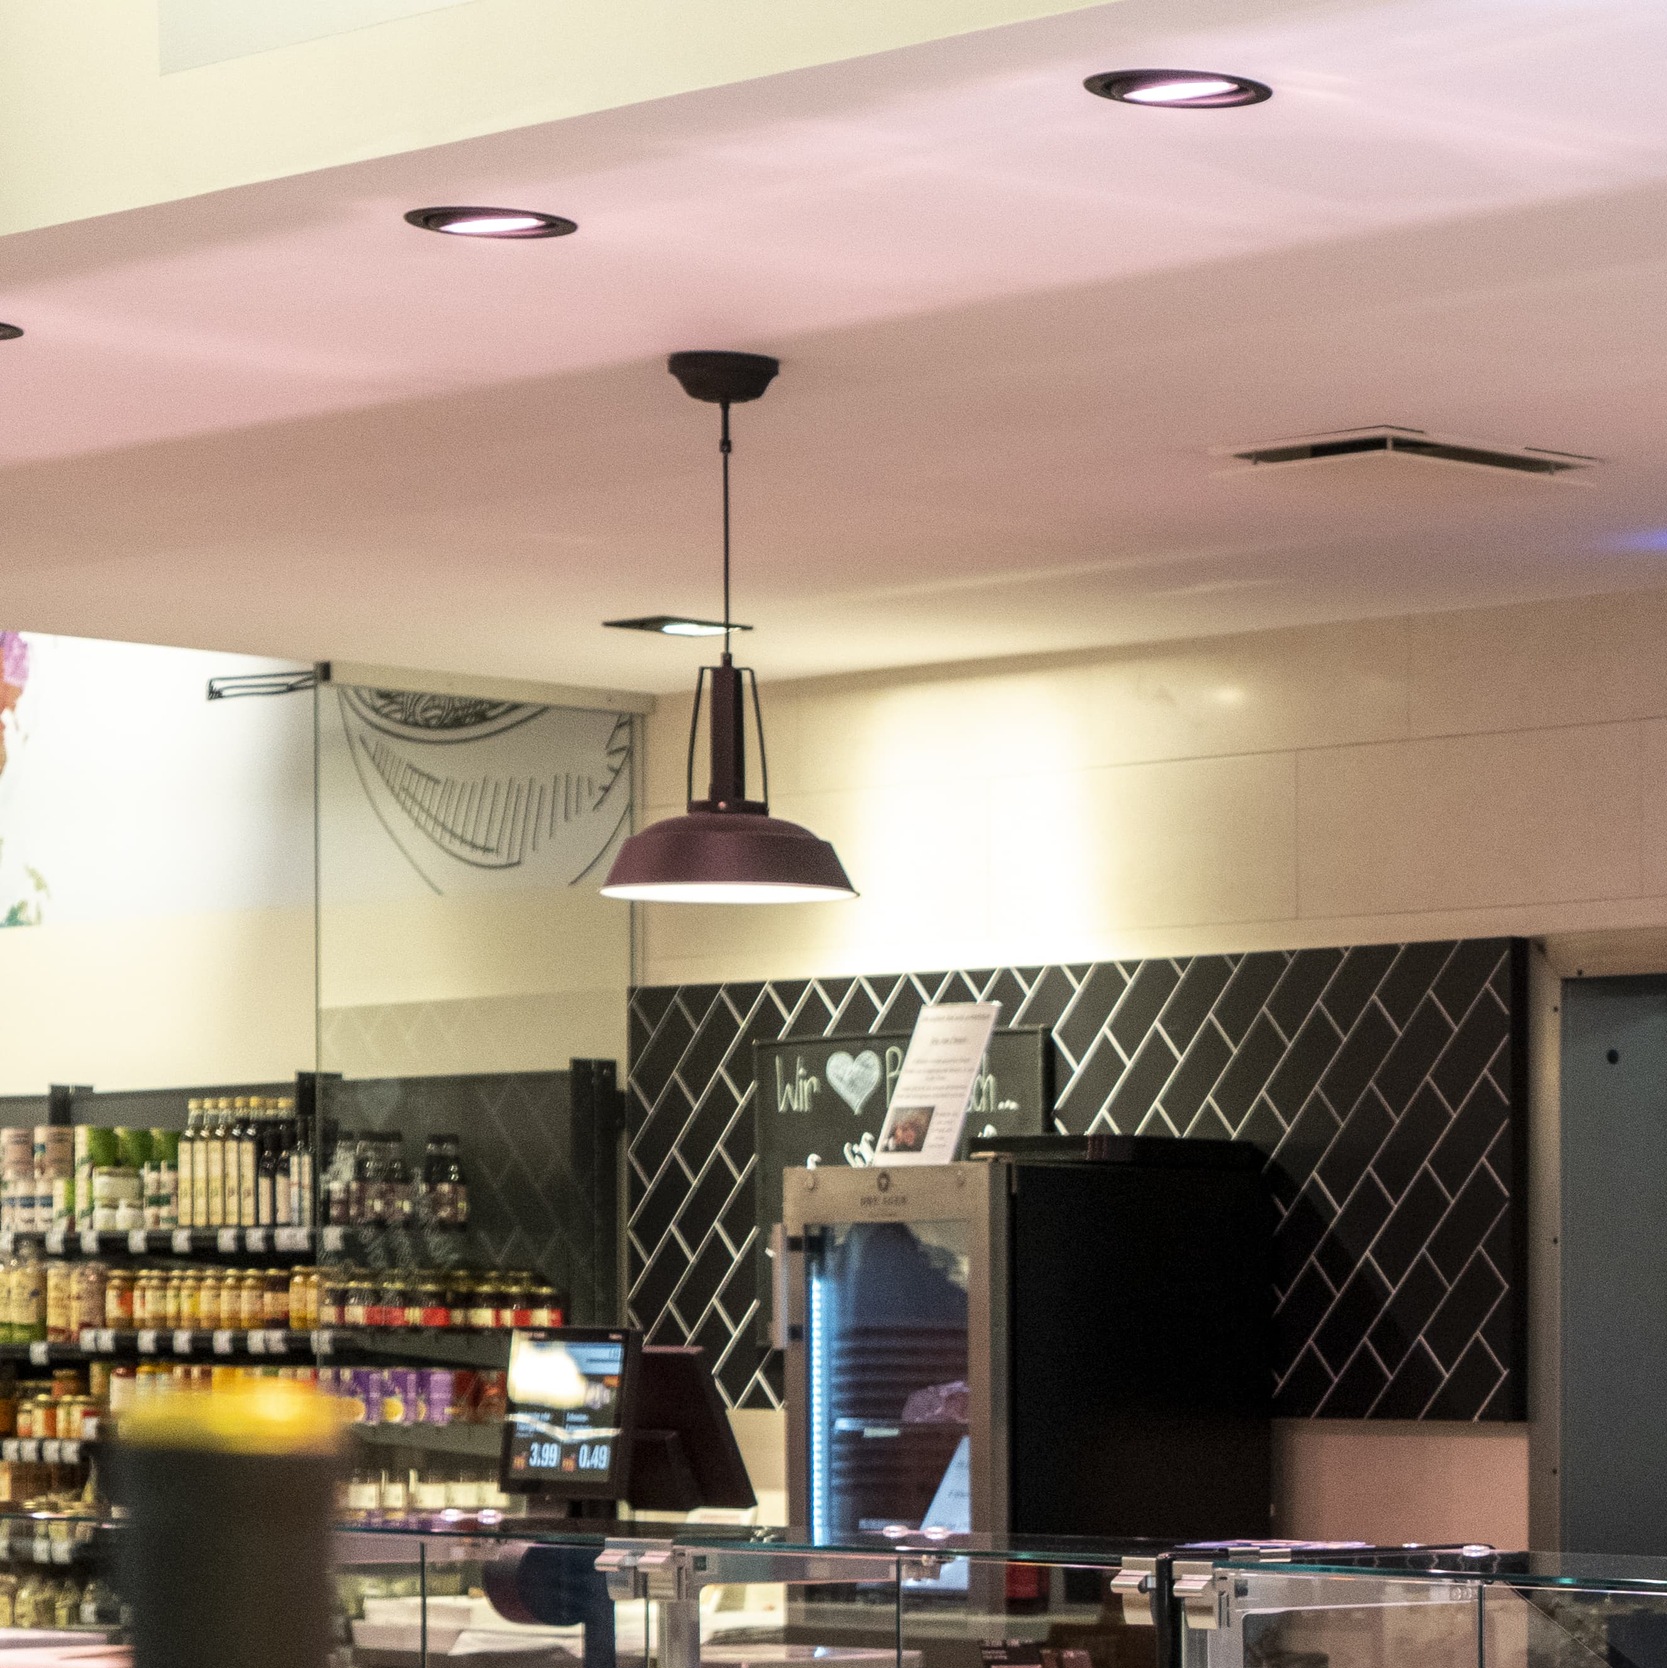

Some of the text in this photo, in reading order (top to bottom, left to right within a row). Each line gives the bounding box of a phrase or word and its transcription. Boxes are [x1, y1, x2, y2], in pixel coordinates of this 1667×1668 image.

[775, 1053, 820, 1113] Wir
[529, 1442, 560, 1468] 3.99
[578, 1444, 611, 1470] 0.49
